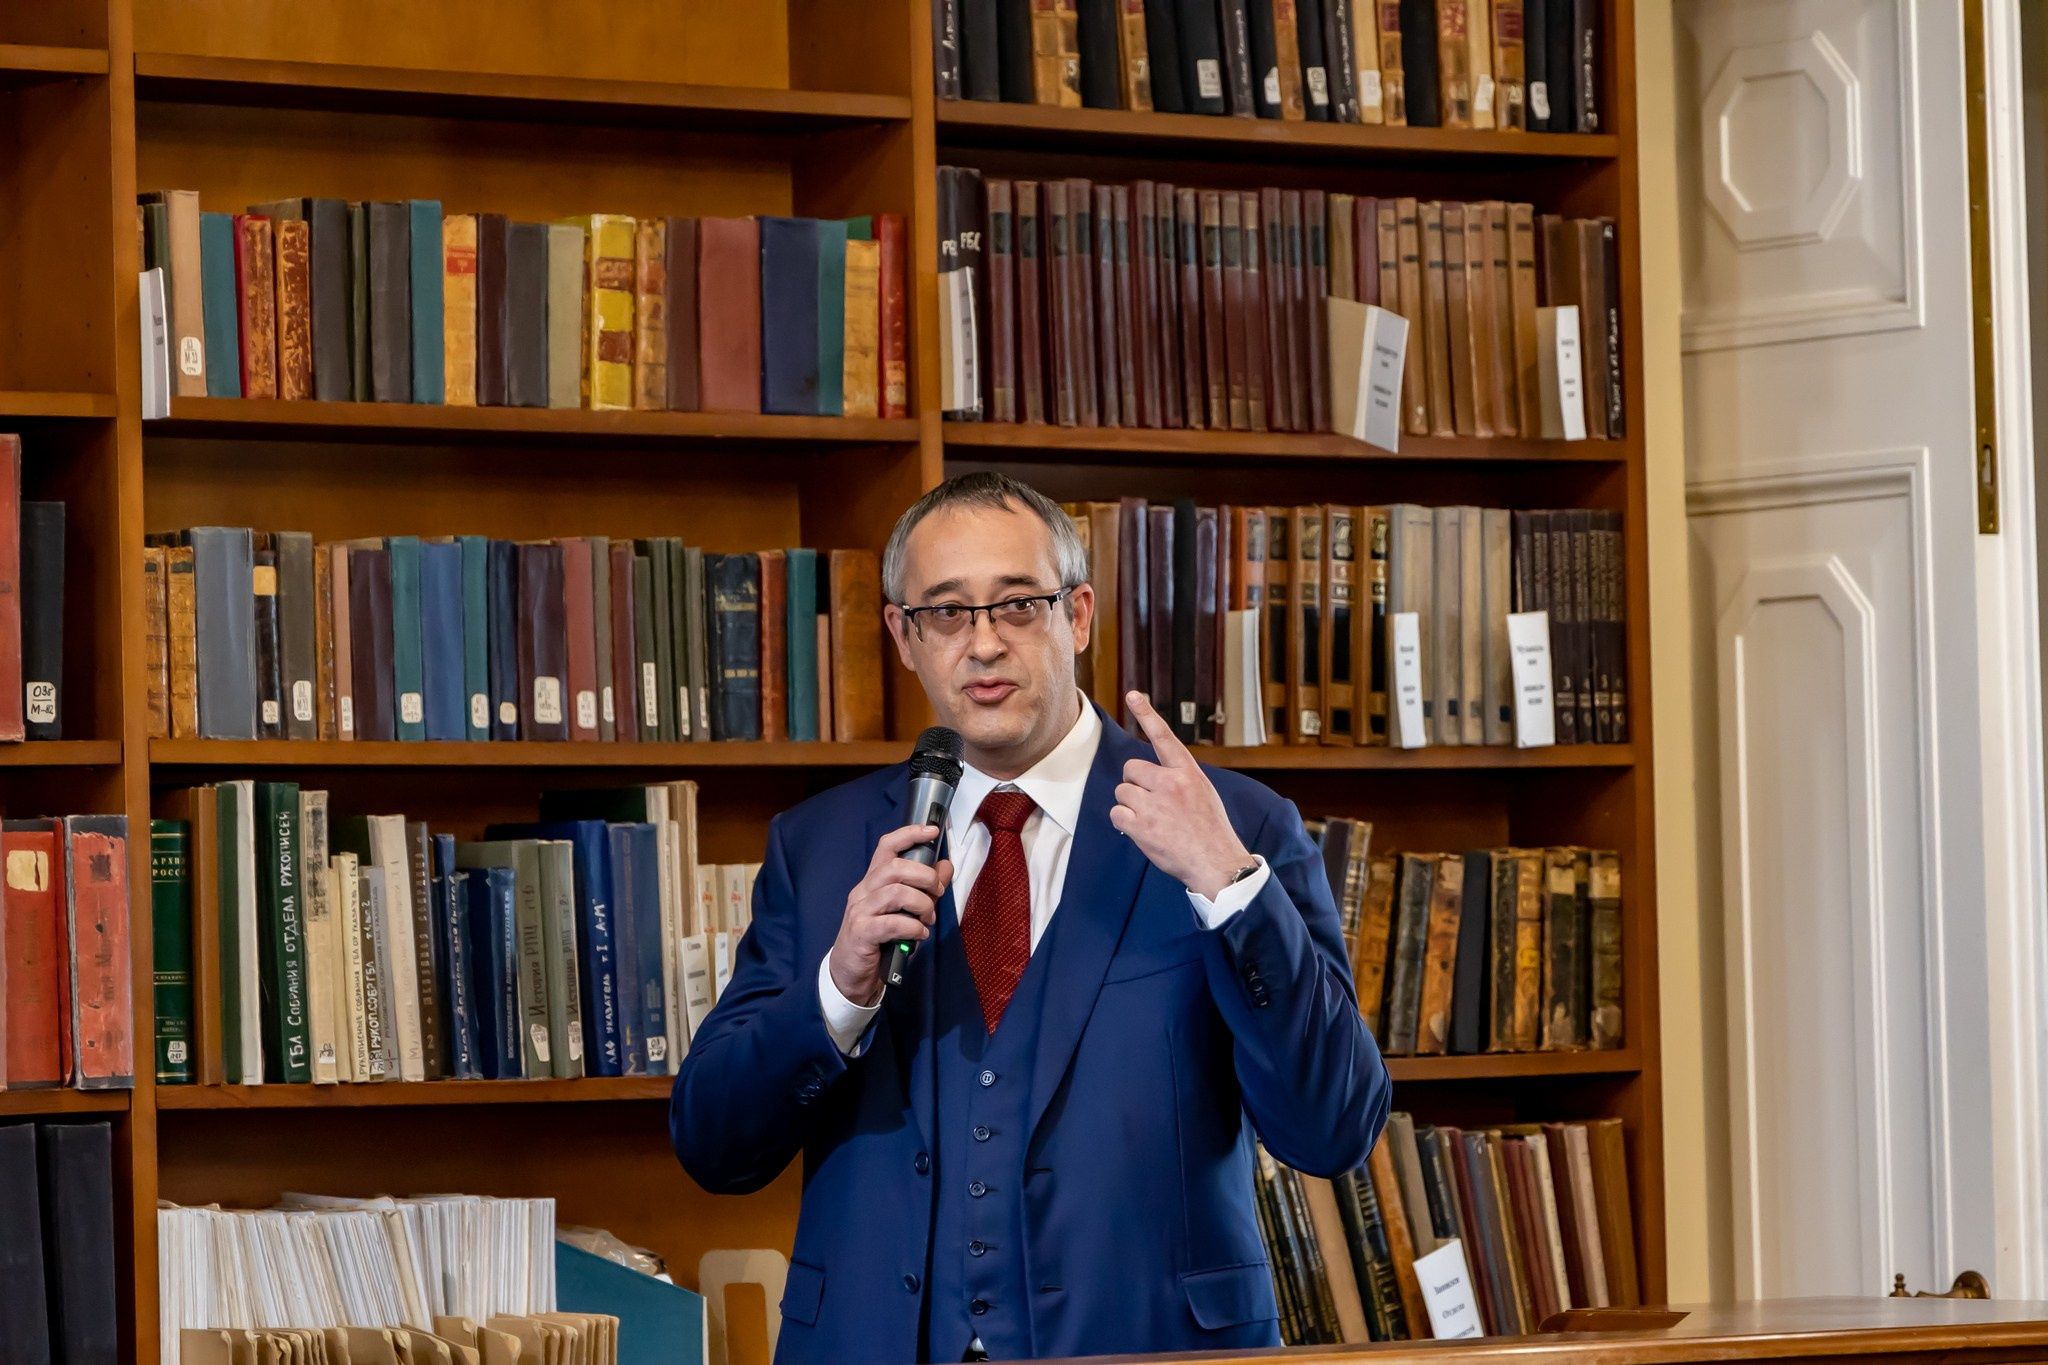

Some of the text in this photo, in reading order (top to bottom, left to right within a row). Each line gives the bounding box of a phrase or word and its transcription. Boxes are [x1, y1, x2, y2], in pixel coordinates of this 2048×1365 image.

[276, 811, 293, 887] РУКОПИСЕЙ
[283, 896, 300, 953] ОТДЕЛА
[523, 924, 539, 957] РПЦ
[528, 961, 546, 1017] История
[288, 1035, 305, 1068] ГБЛ
